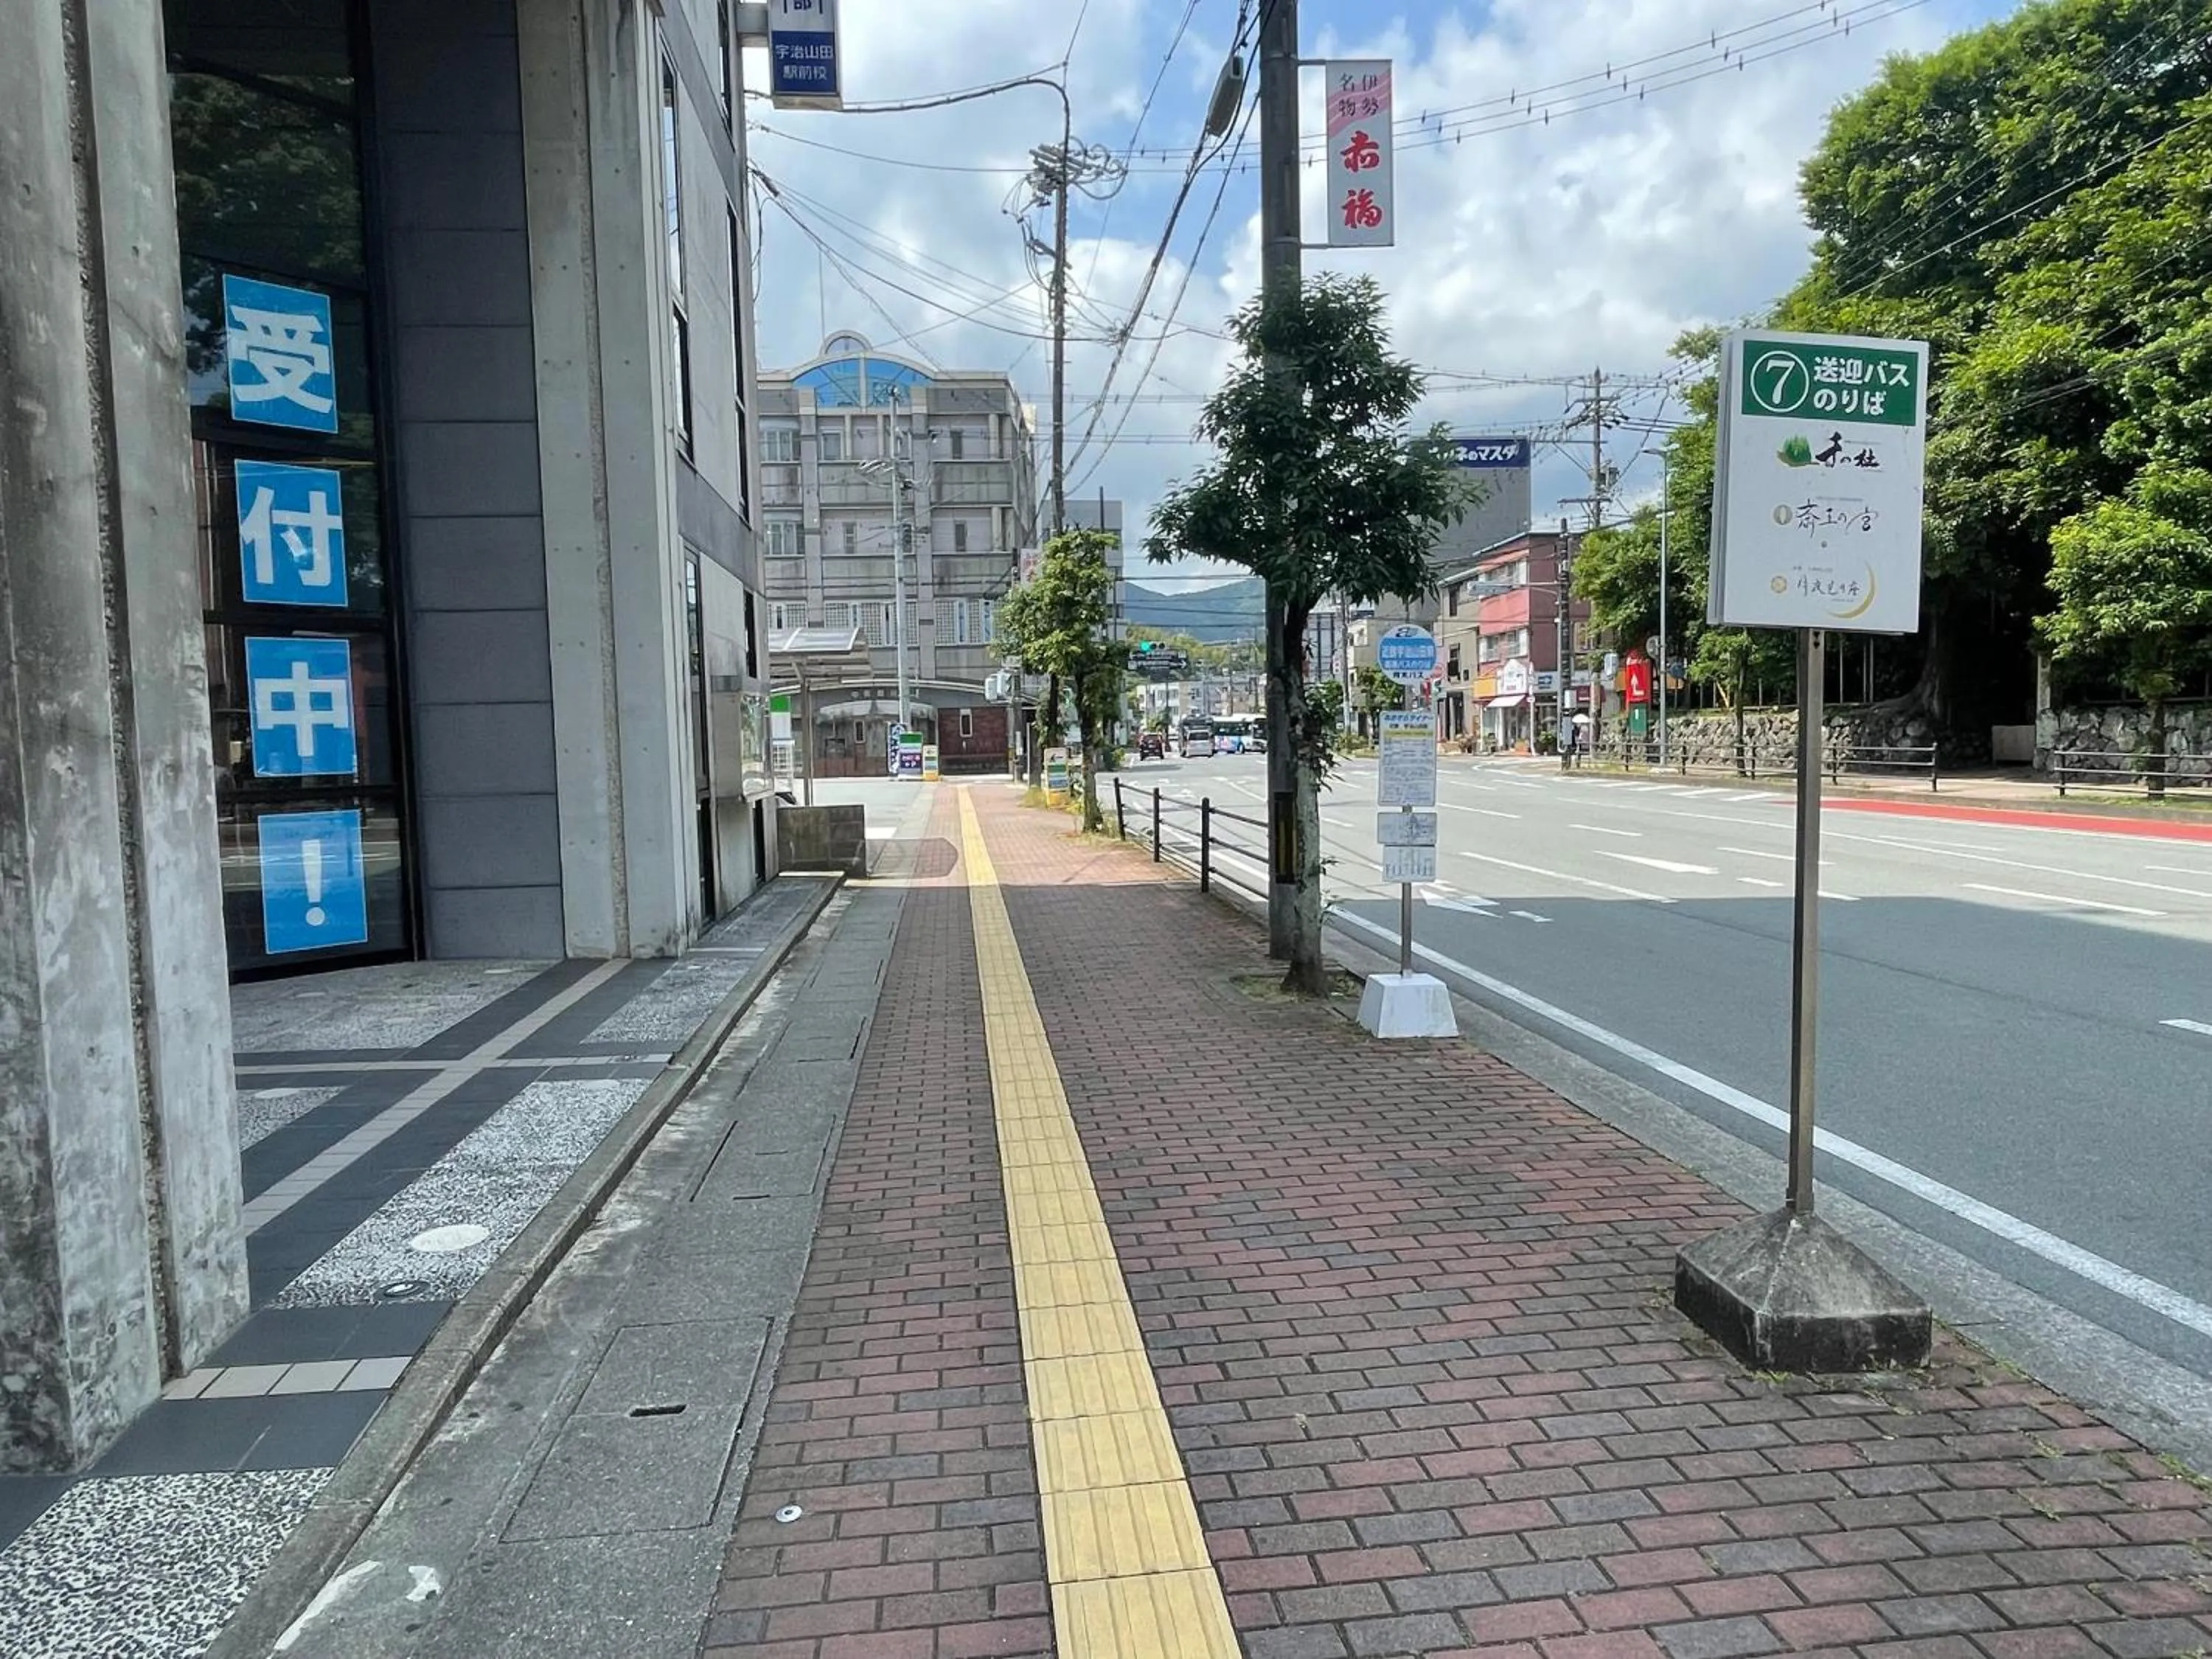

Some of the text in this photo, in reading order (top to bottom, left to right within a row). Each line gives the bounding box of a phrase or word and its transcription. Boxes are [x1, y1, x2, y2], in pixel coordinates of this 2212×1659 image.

[775, 45, 834, 60] 宇治山田
[782, 65, 827, 80] 駅前校
[1338, 74, 1356, 116] 名物
[1361, 74, 1380, 116] 伊勢
[1340, 131, 1382, 229] 赤福
[1814, 357, 1910, 388] 送迎バス
[1813, 391, 1886, 416] のりば
